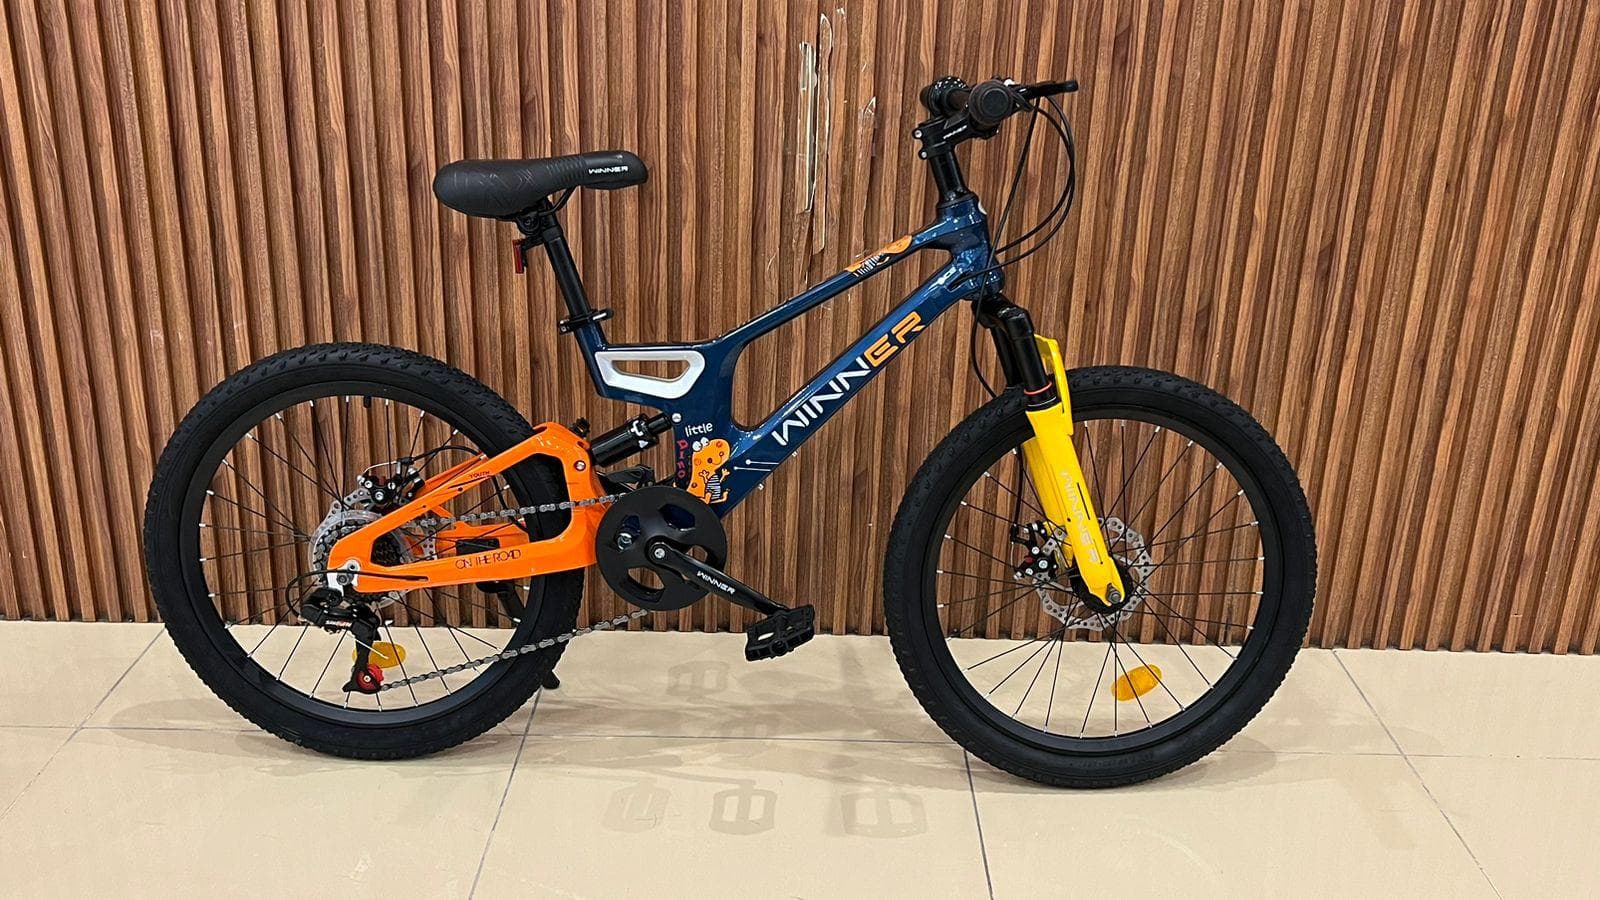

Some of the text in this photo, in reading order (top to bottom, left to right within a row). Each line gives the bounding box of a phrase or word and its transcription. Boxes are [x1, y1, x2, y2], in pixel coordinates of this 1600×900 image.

[588, 165, 628, 175] WINNER
[771, 311, 926, 447] WINNER
[684, 422, 713, 438] little
[492, 549, 522, 563] ROAD
[697, 570, 736, 595] WINNER
